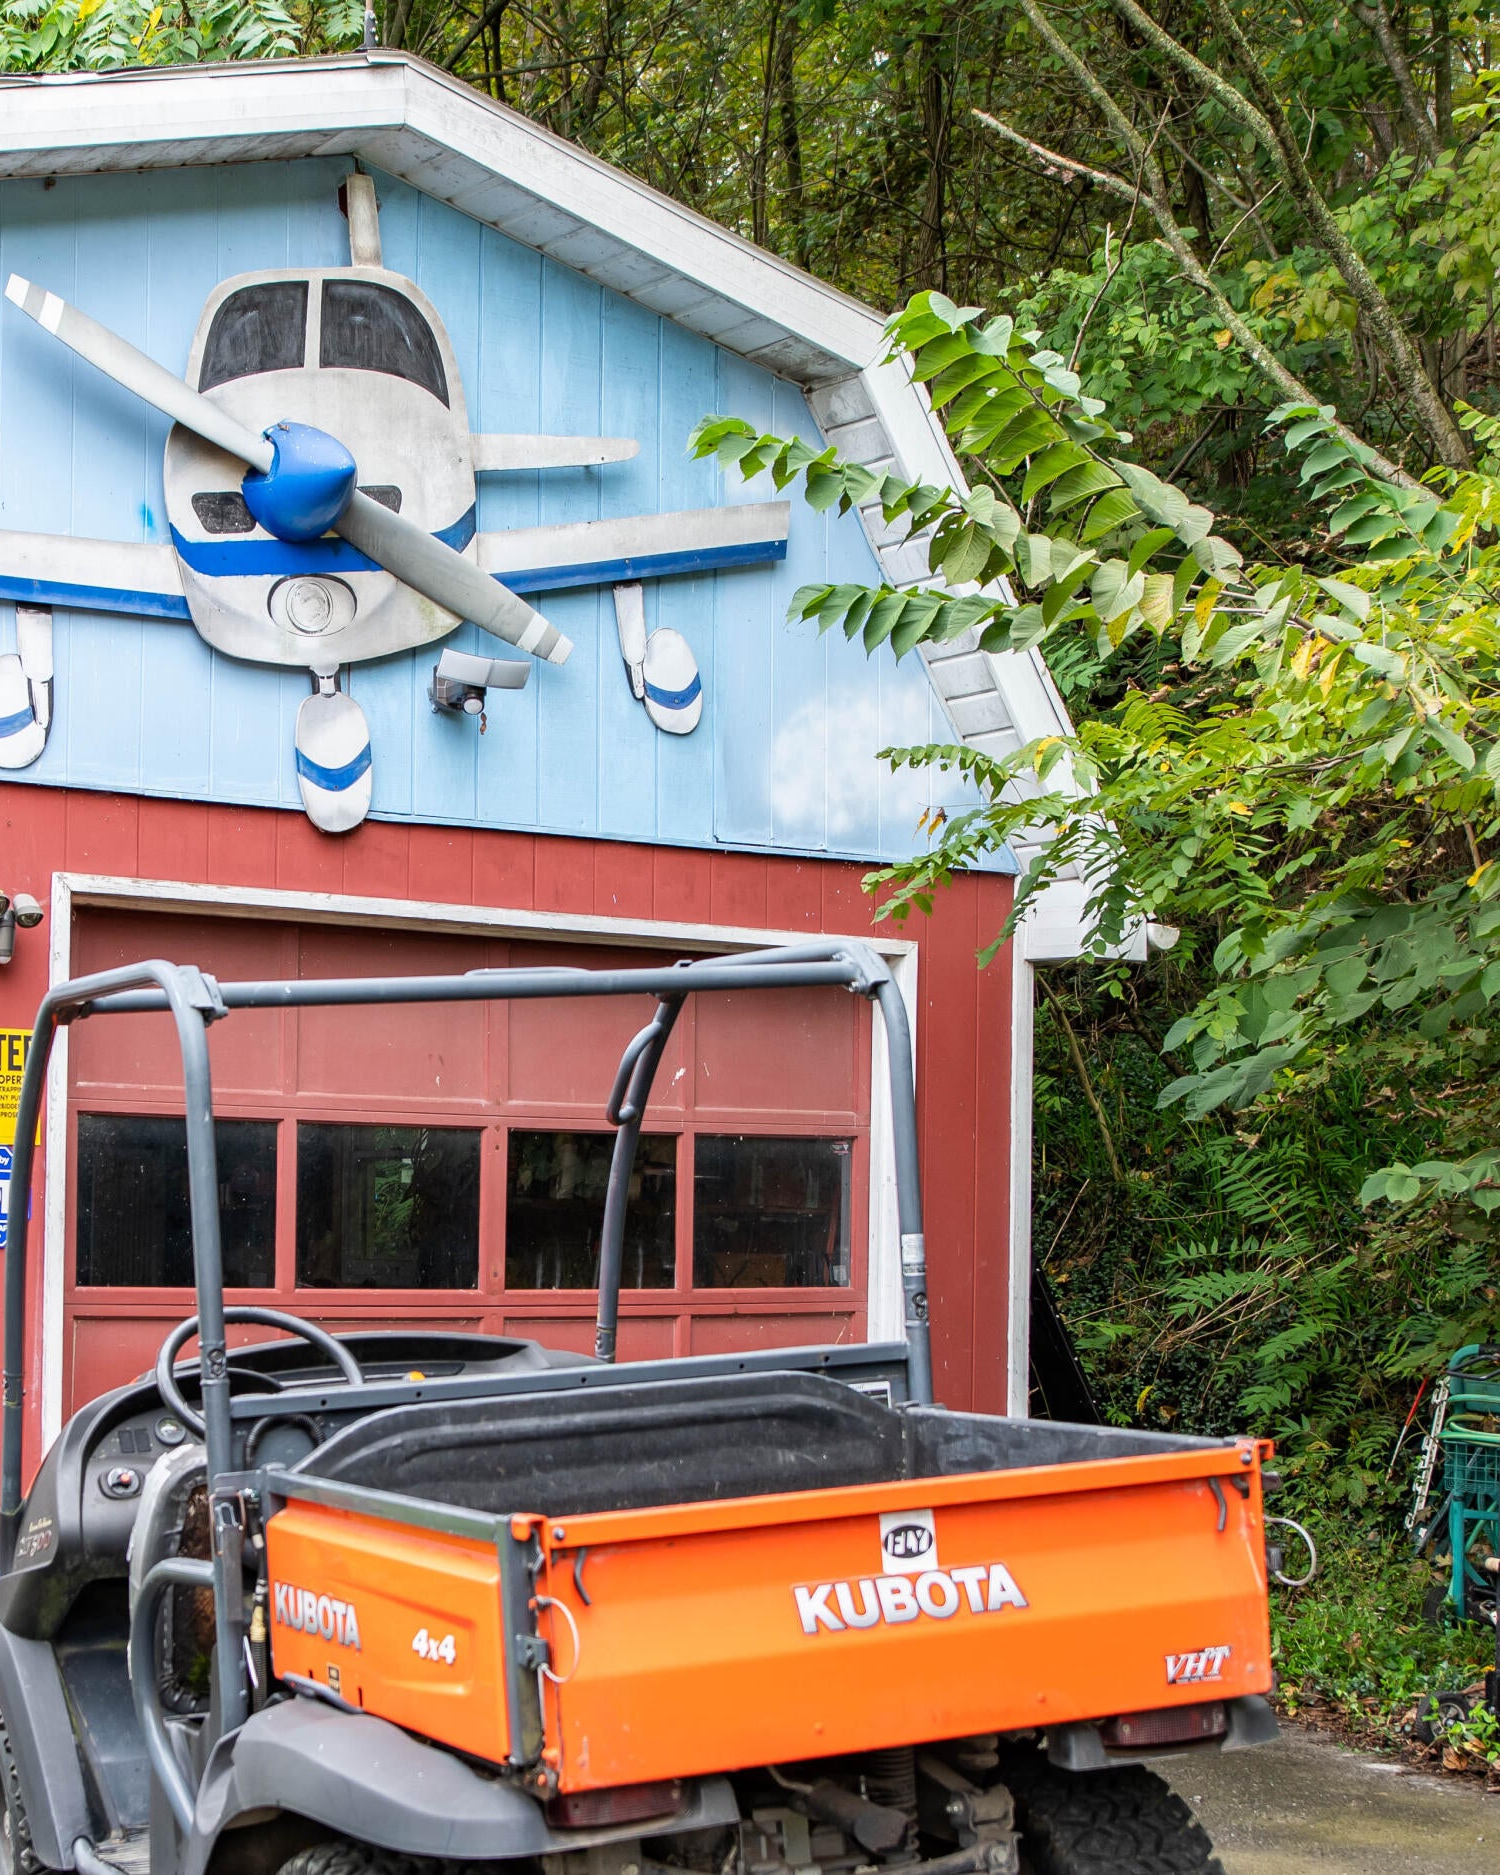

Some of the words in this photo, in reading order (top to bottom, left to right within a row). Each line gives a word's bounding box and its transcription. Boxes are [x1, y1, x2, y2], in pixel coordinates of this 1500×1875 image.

[273, 1581, 362, 1651] KUBOTA
[792, 1562, 1029, 1635] KUBOTA
[411, 1628, 457, 1665] 4x4
[1164, 1645, 1231, 1684] VHT
